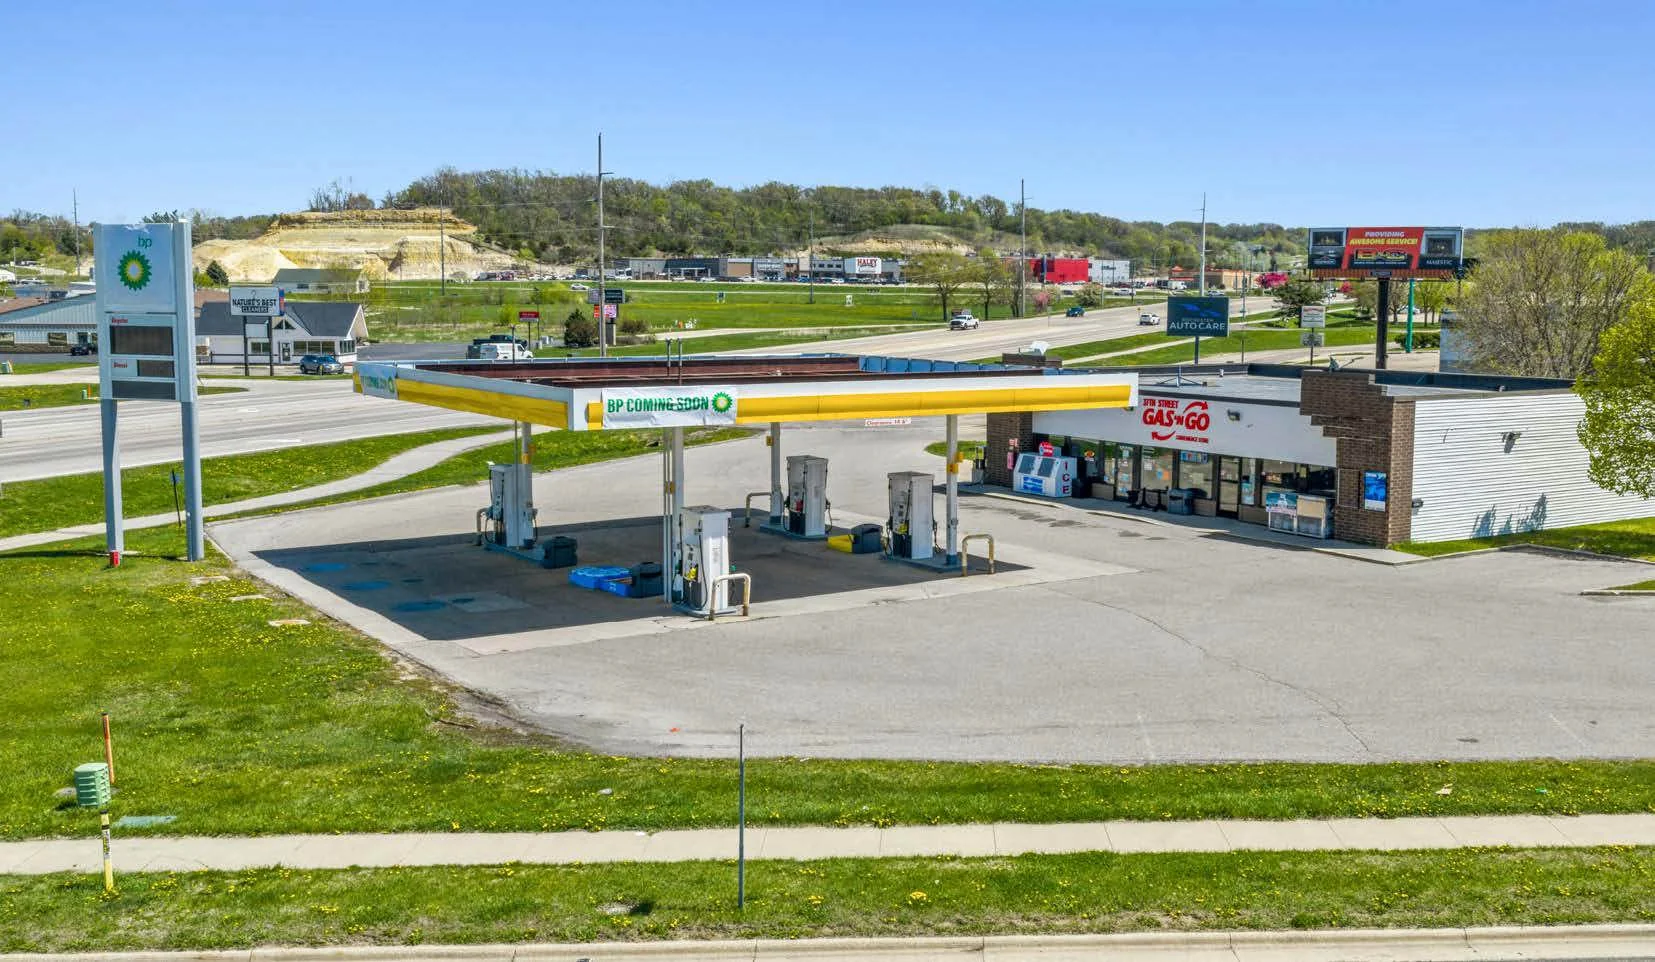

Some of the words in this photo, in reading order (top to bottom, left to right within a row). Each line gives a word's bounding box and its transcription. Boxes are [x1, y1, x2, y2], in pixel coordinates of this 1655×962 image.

[138, 236, 152, 249] bp
[857, 258, 877, 266] HALEY
[1170, 322, 1196, 330] AUTO
[608, 399, 624, 412] BP
[626, 398, 674, 412] COMING
[676, 396, 708, 411] SOON
[1158, 400, 1178, 408] STREET
[1143, 408, 1174, 427] GAS
[1185, 412, 1210, 431] GO
[1062, 462, 1071, 494] ICE
